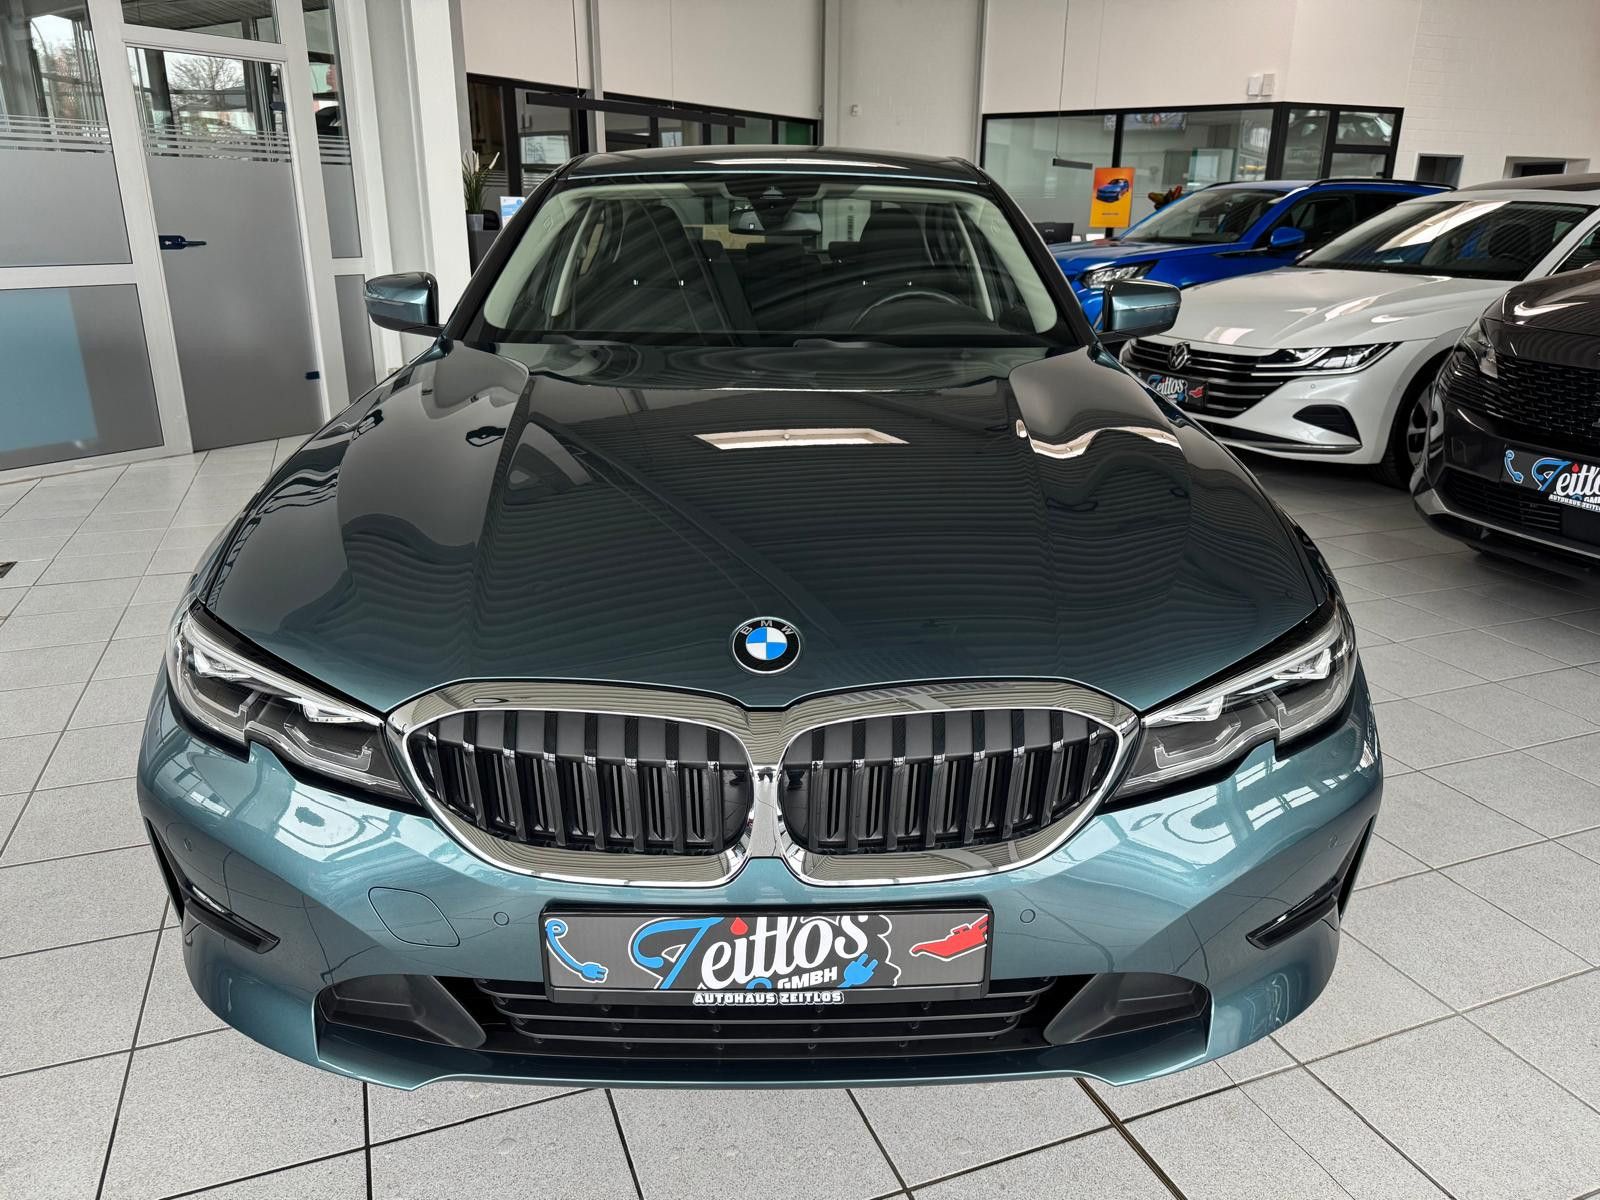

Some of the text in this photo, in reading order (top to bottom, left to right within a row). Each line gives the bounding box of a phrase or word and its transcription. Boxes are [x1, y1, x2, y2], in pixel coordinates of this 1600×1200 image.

[740, 620, 794, 636] BMW
[777, 966, 838, 989] GMBH
[693, 991, 844, 1005] AUTOHAUS ZEITLOS
